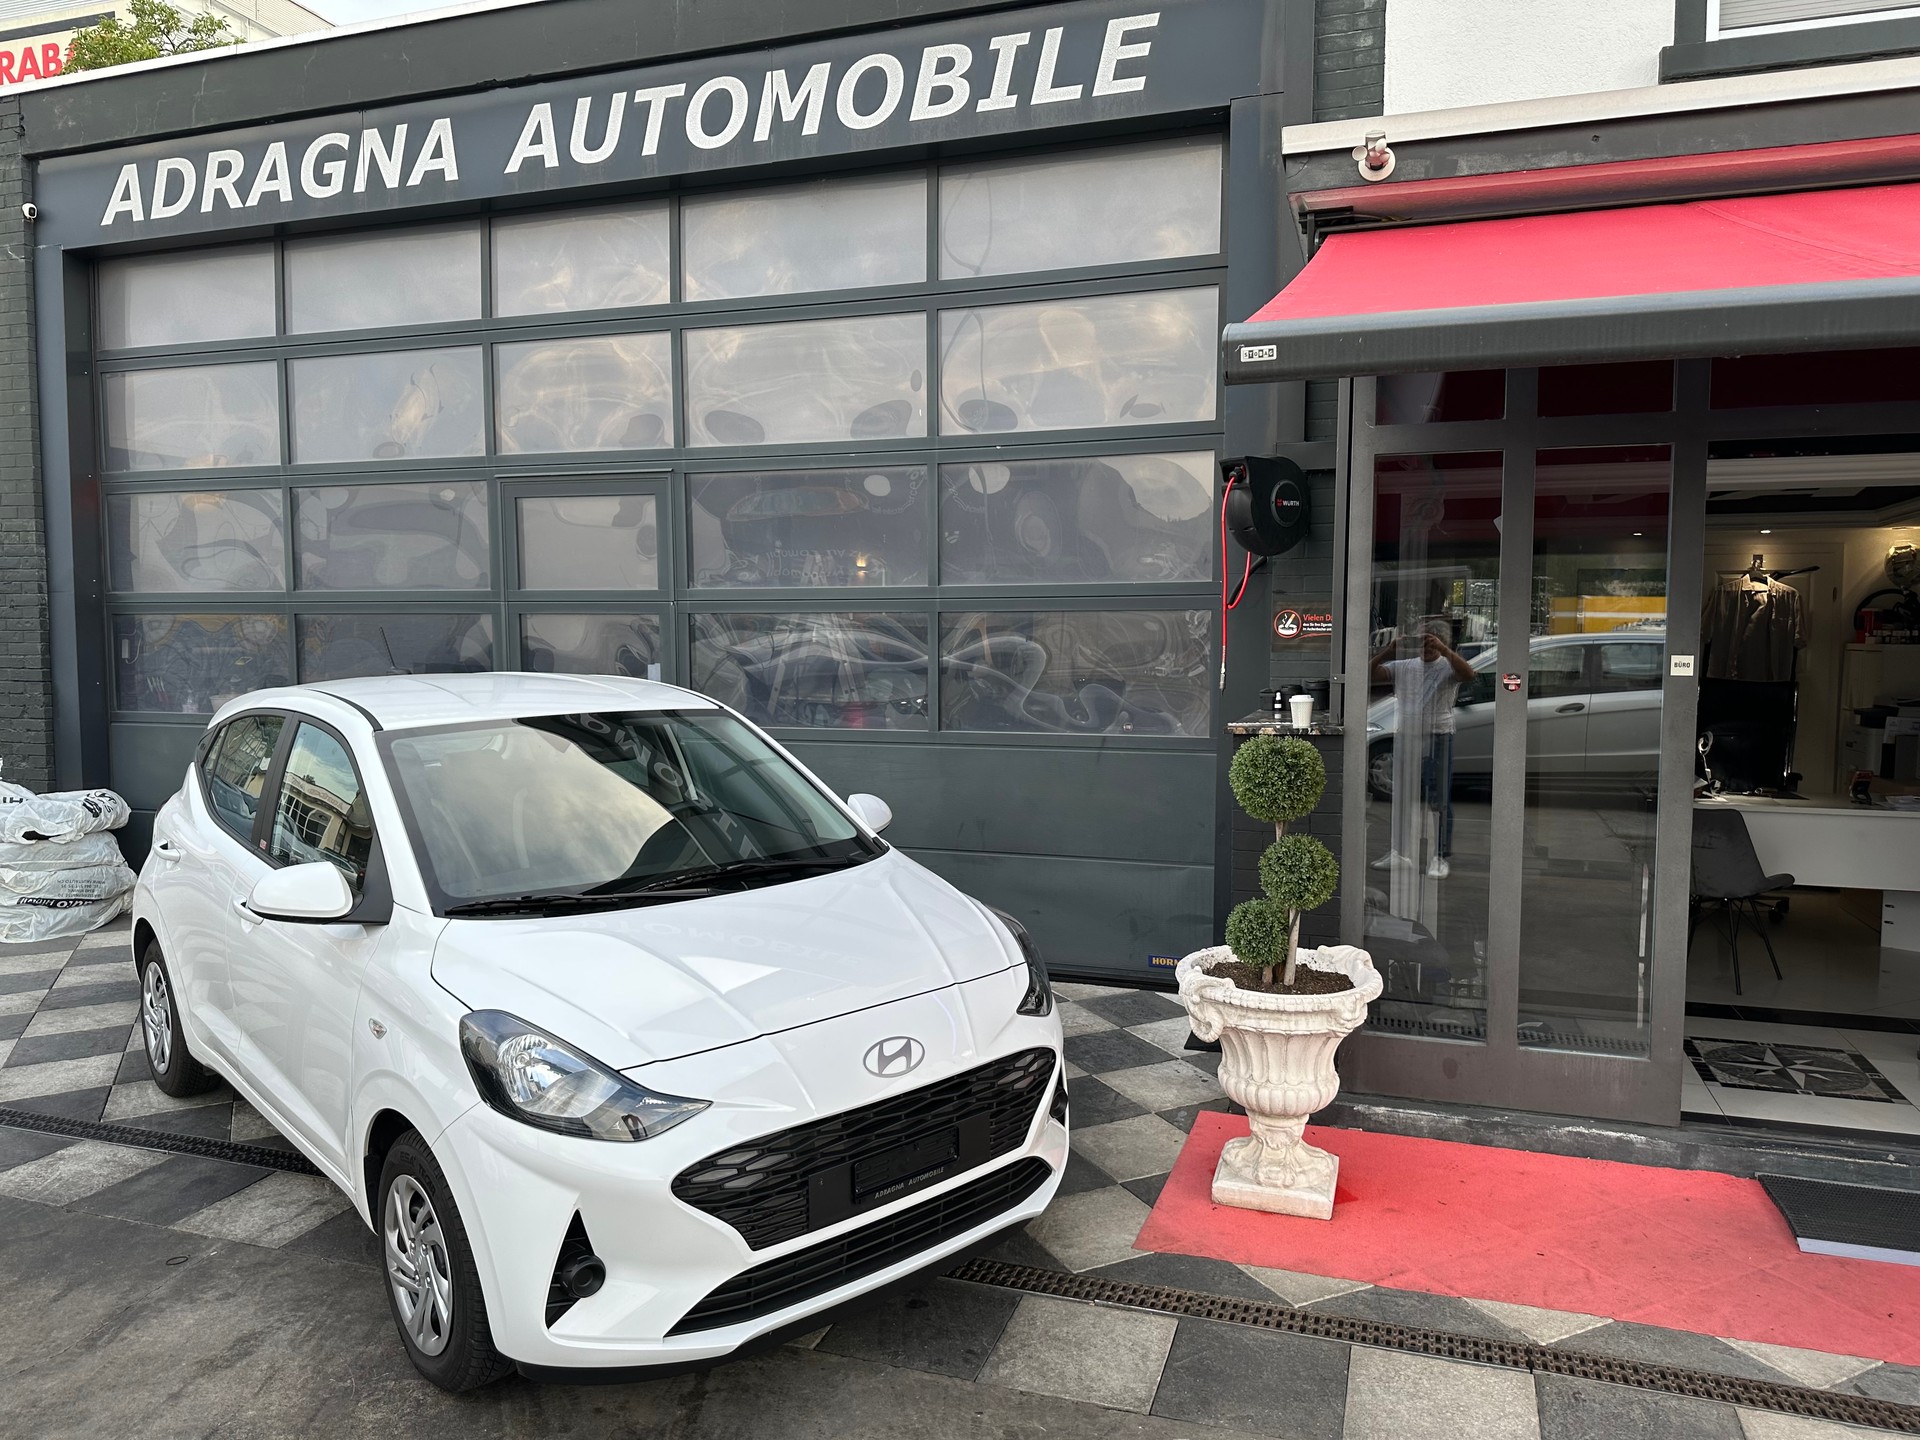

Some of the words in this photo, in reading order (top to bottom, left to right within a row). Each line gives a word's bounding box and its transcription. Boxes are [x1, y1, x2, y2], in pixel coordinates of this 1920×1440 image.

[0, 42, 75, 85] RAB
[100, 117, 460, 227] ADRAGNA
[503, 11, 1161, 175] AUTOMOBILE
[874, 1182, 905, 1199] ADRAGNA
[908, 1166, 945, 1186] AUTOMOBILE
